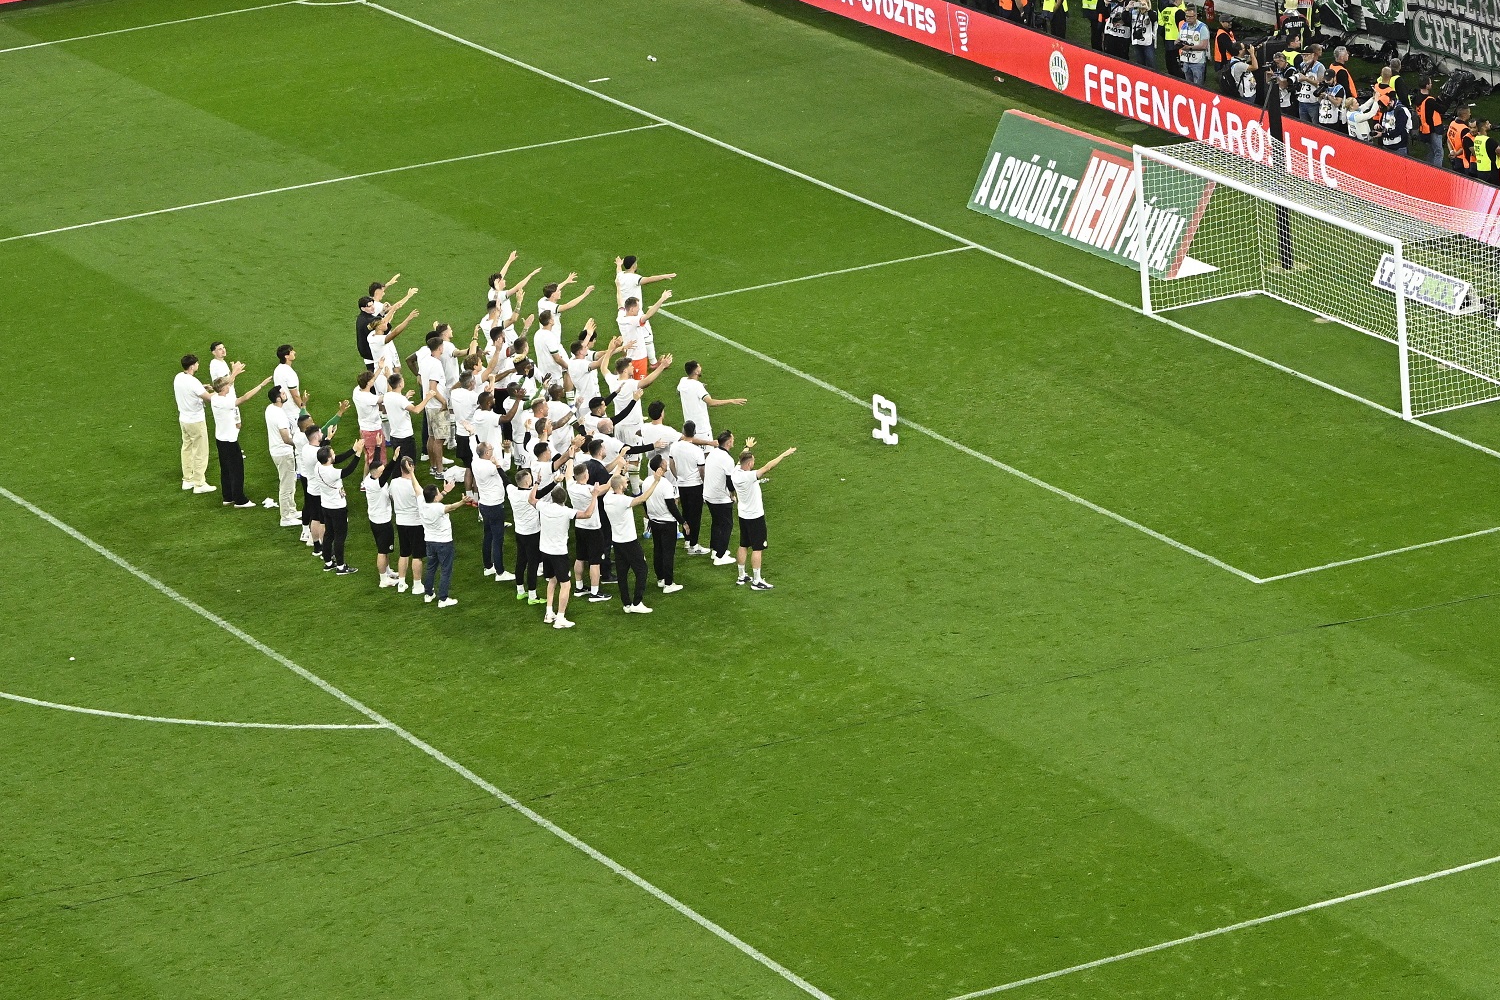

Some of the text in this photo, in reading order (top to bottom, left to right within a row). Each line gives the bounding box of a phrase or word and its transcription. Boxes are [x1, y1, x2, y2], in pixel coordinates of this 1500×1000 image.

[1084, 62, 1293, 171] FERENCVÁROI
[1301, 137, 1339, 188] TC
[974, 152, 1001, 205] A
[1062, 156, 1137, 251] NEM
[1381, 261, 1463, 307] TPPMIX
